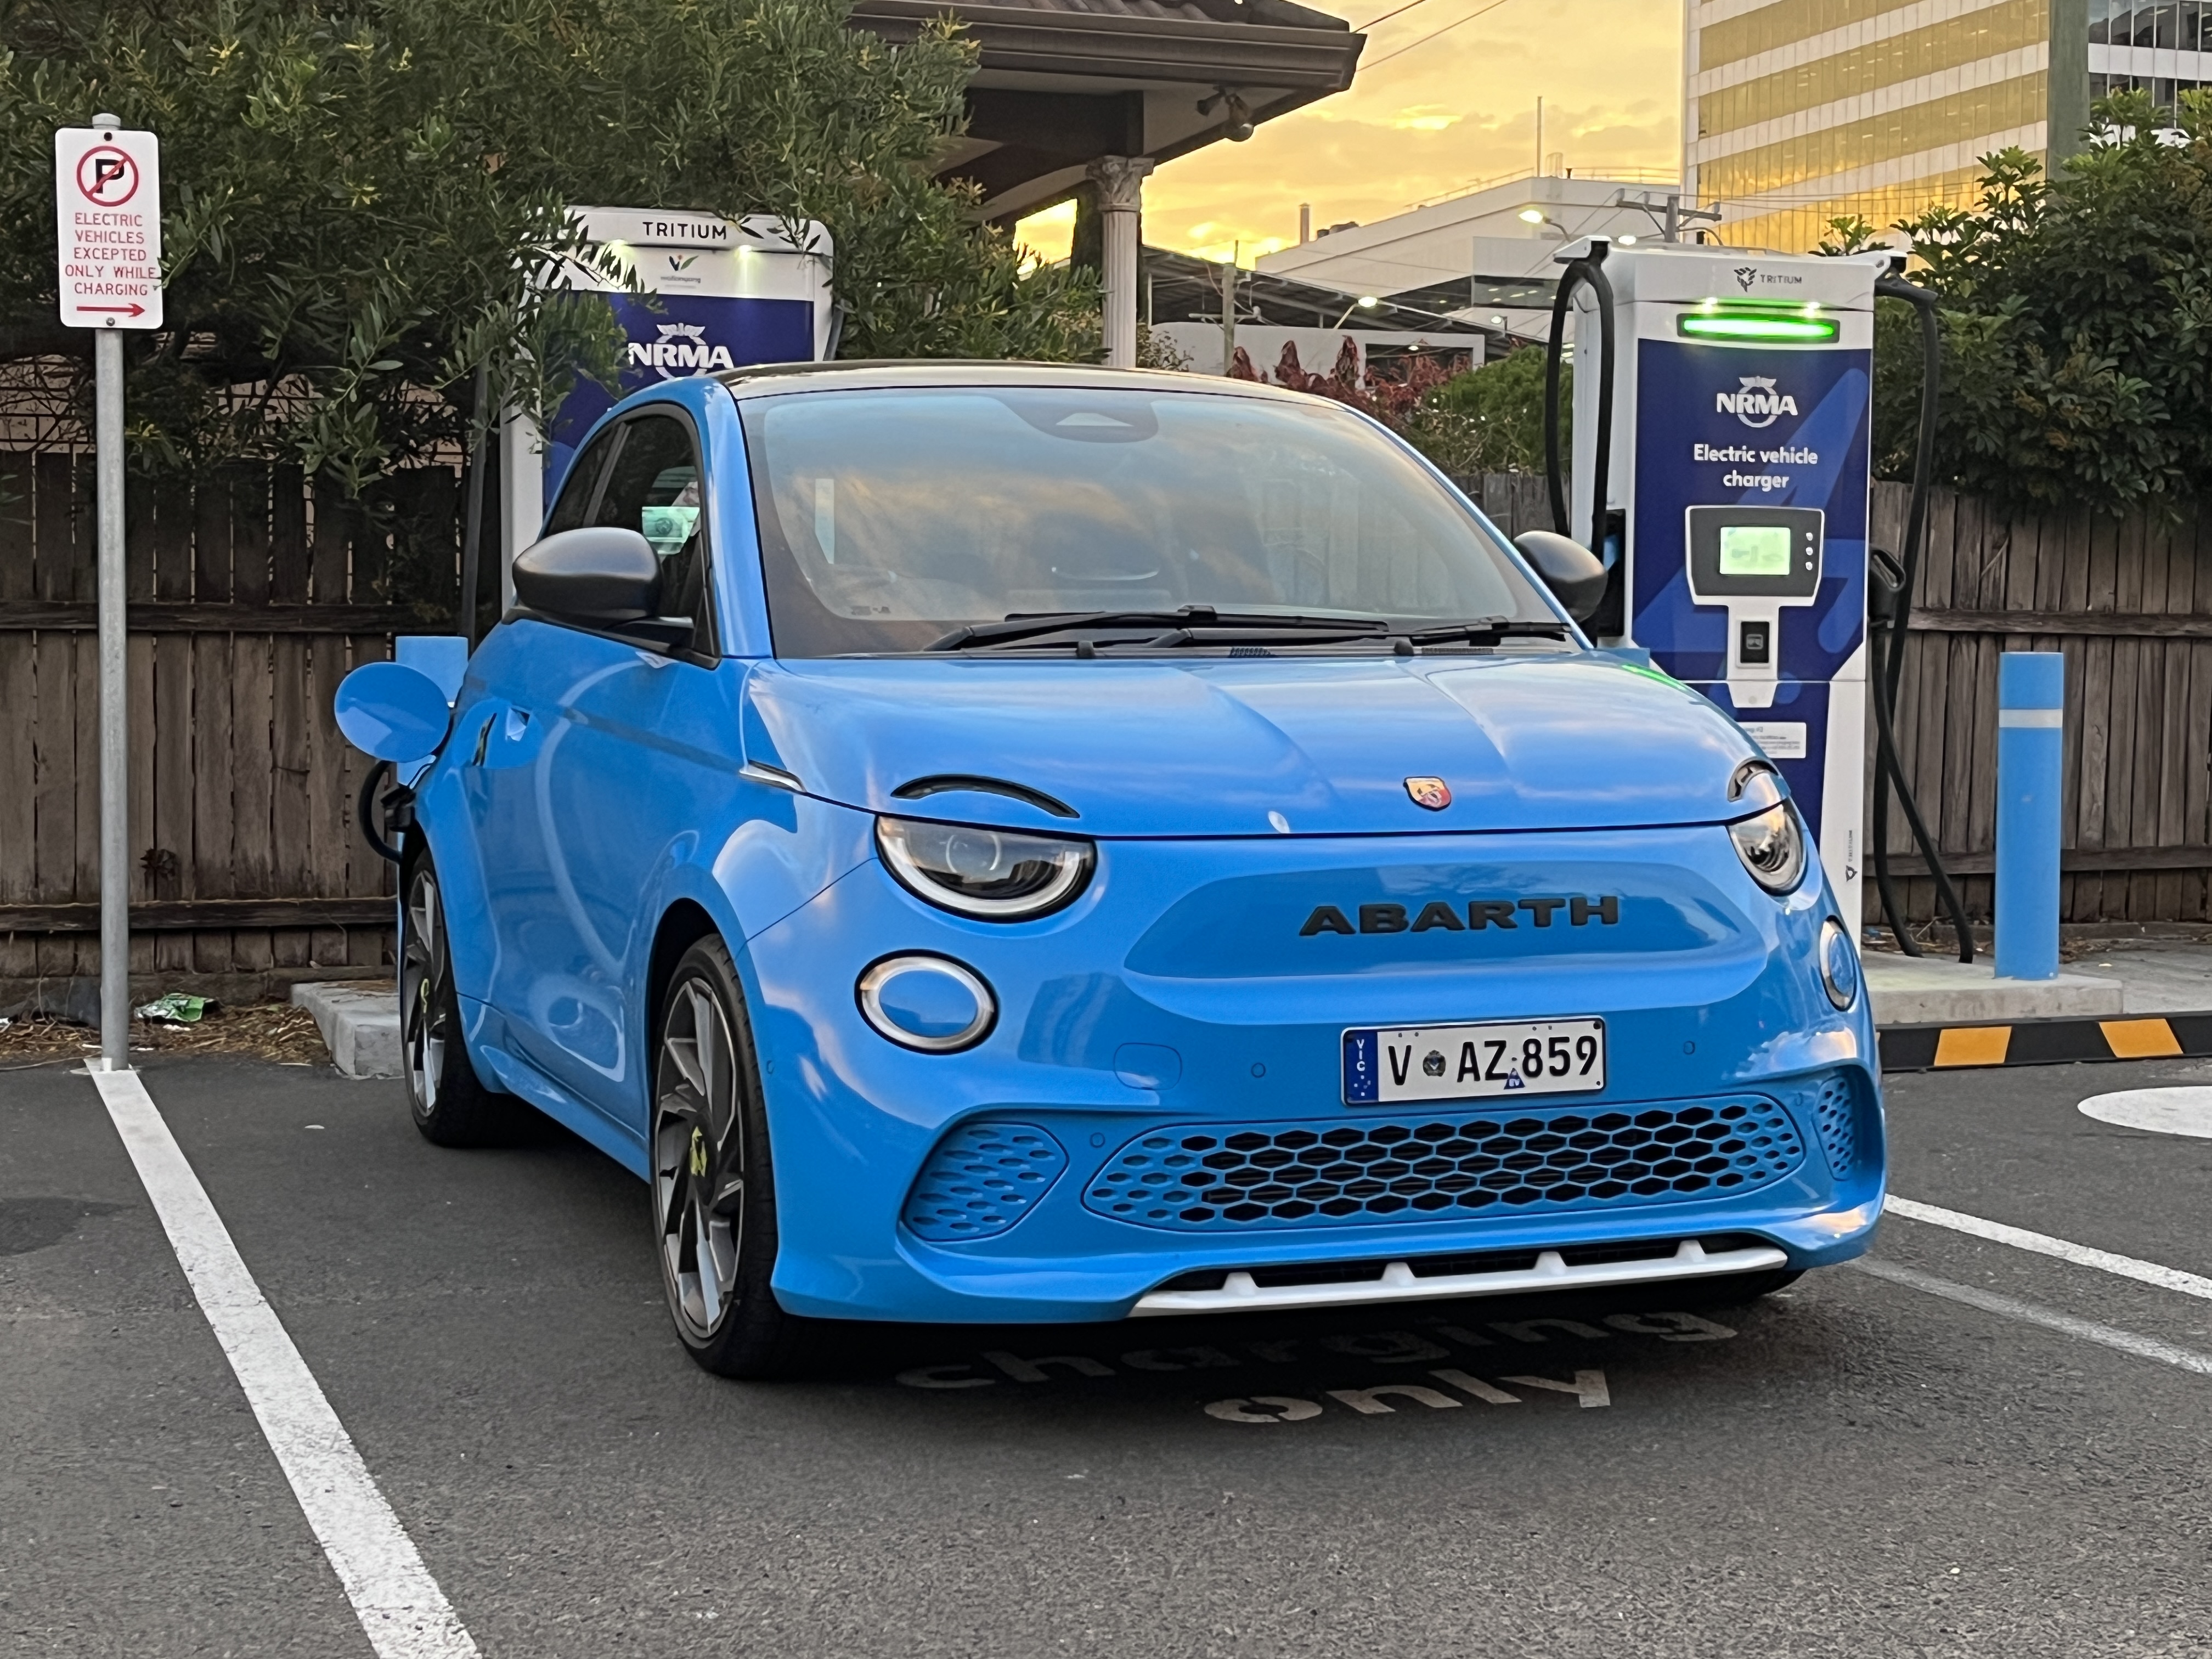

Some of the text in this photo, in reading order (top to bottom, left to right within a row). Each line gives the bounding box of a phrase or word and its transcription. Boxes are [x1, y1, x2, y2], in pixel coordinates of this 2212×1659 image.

[95, 159, 125, 194] P
[75, 213, 143, 227] ELECTRIC
[642, 221, 727, 240] TRITIUM
[75, 230, 144, 244] VEHICLES
[74, 247, 146, 261] EXCEPTED
[65, 264, 156, 279] ONLY WHILE
[1760, 274, 1802, 284] TRITIUM
[75, 283, 148, 296] CHARGING
[628, 342, 734, 369] NRMA
[1717, 393, 1798, 416] NRMA
[1694, 444, 1818, 465] Electric vehicle
[1723, 470, 1789, 492] charger
[1299, 896, 1619, 936] ABARTH
[1387, 1045, 1412, 1086] V
[895, 1311, 1737, 1388] charging
[1204, 1368, 1610, 1423] only
